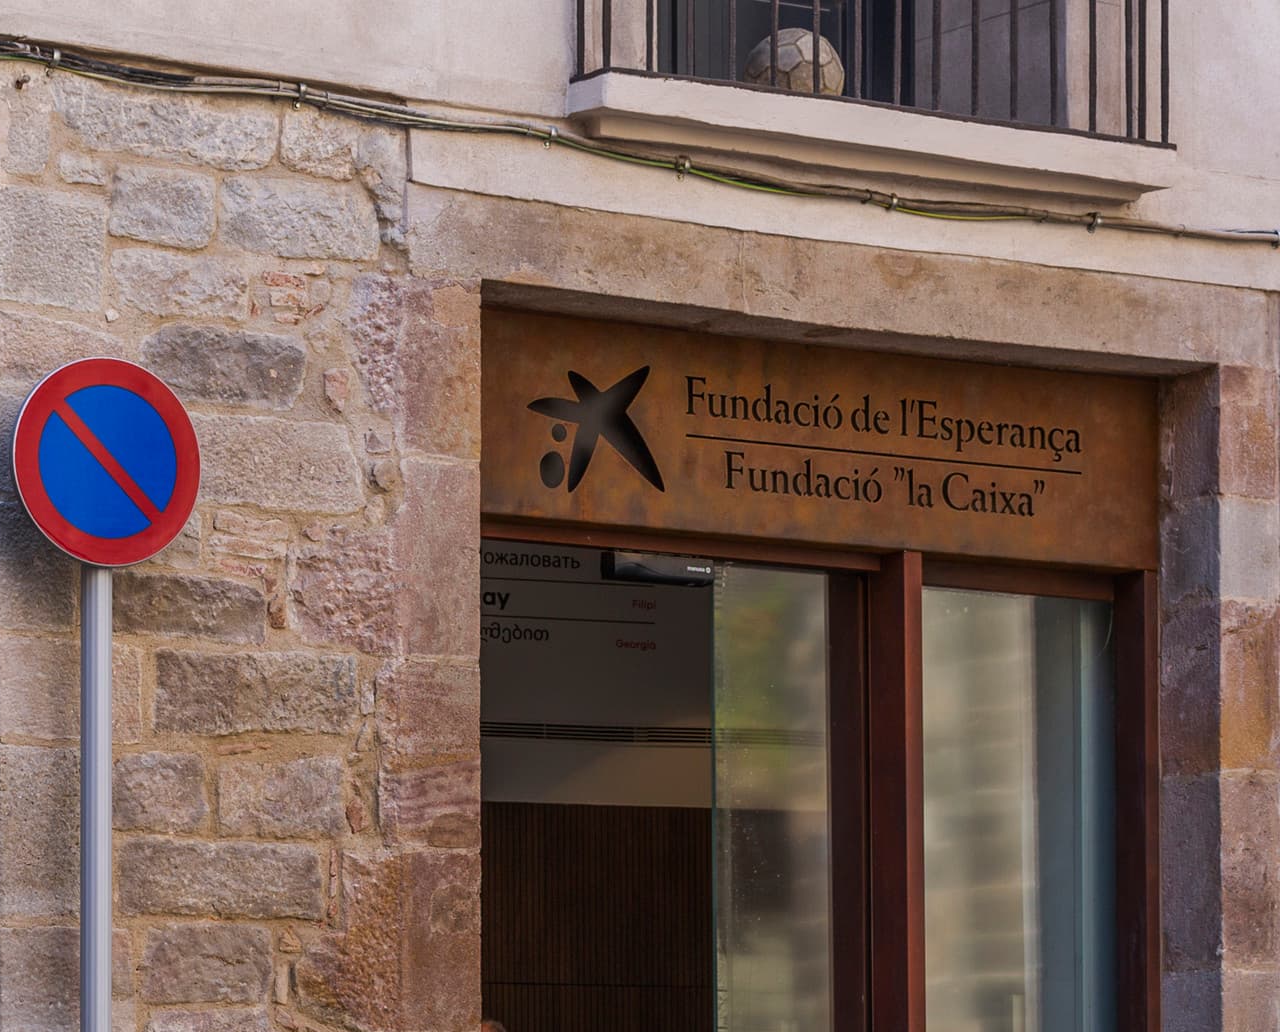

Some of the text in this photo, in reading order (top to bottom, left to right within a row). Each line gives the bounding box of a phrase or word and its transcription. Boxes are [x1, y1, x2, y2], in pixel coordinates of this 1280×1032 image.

[685, 375, 1082, 463] Fundació de l'Esperança
[724, 450, 883, 504] Fundació
[480, 551, 581, 570] ожаловать
